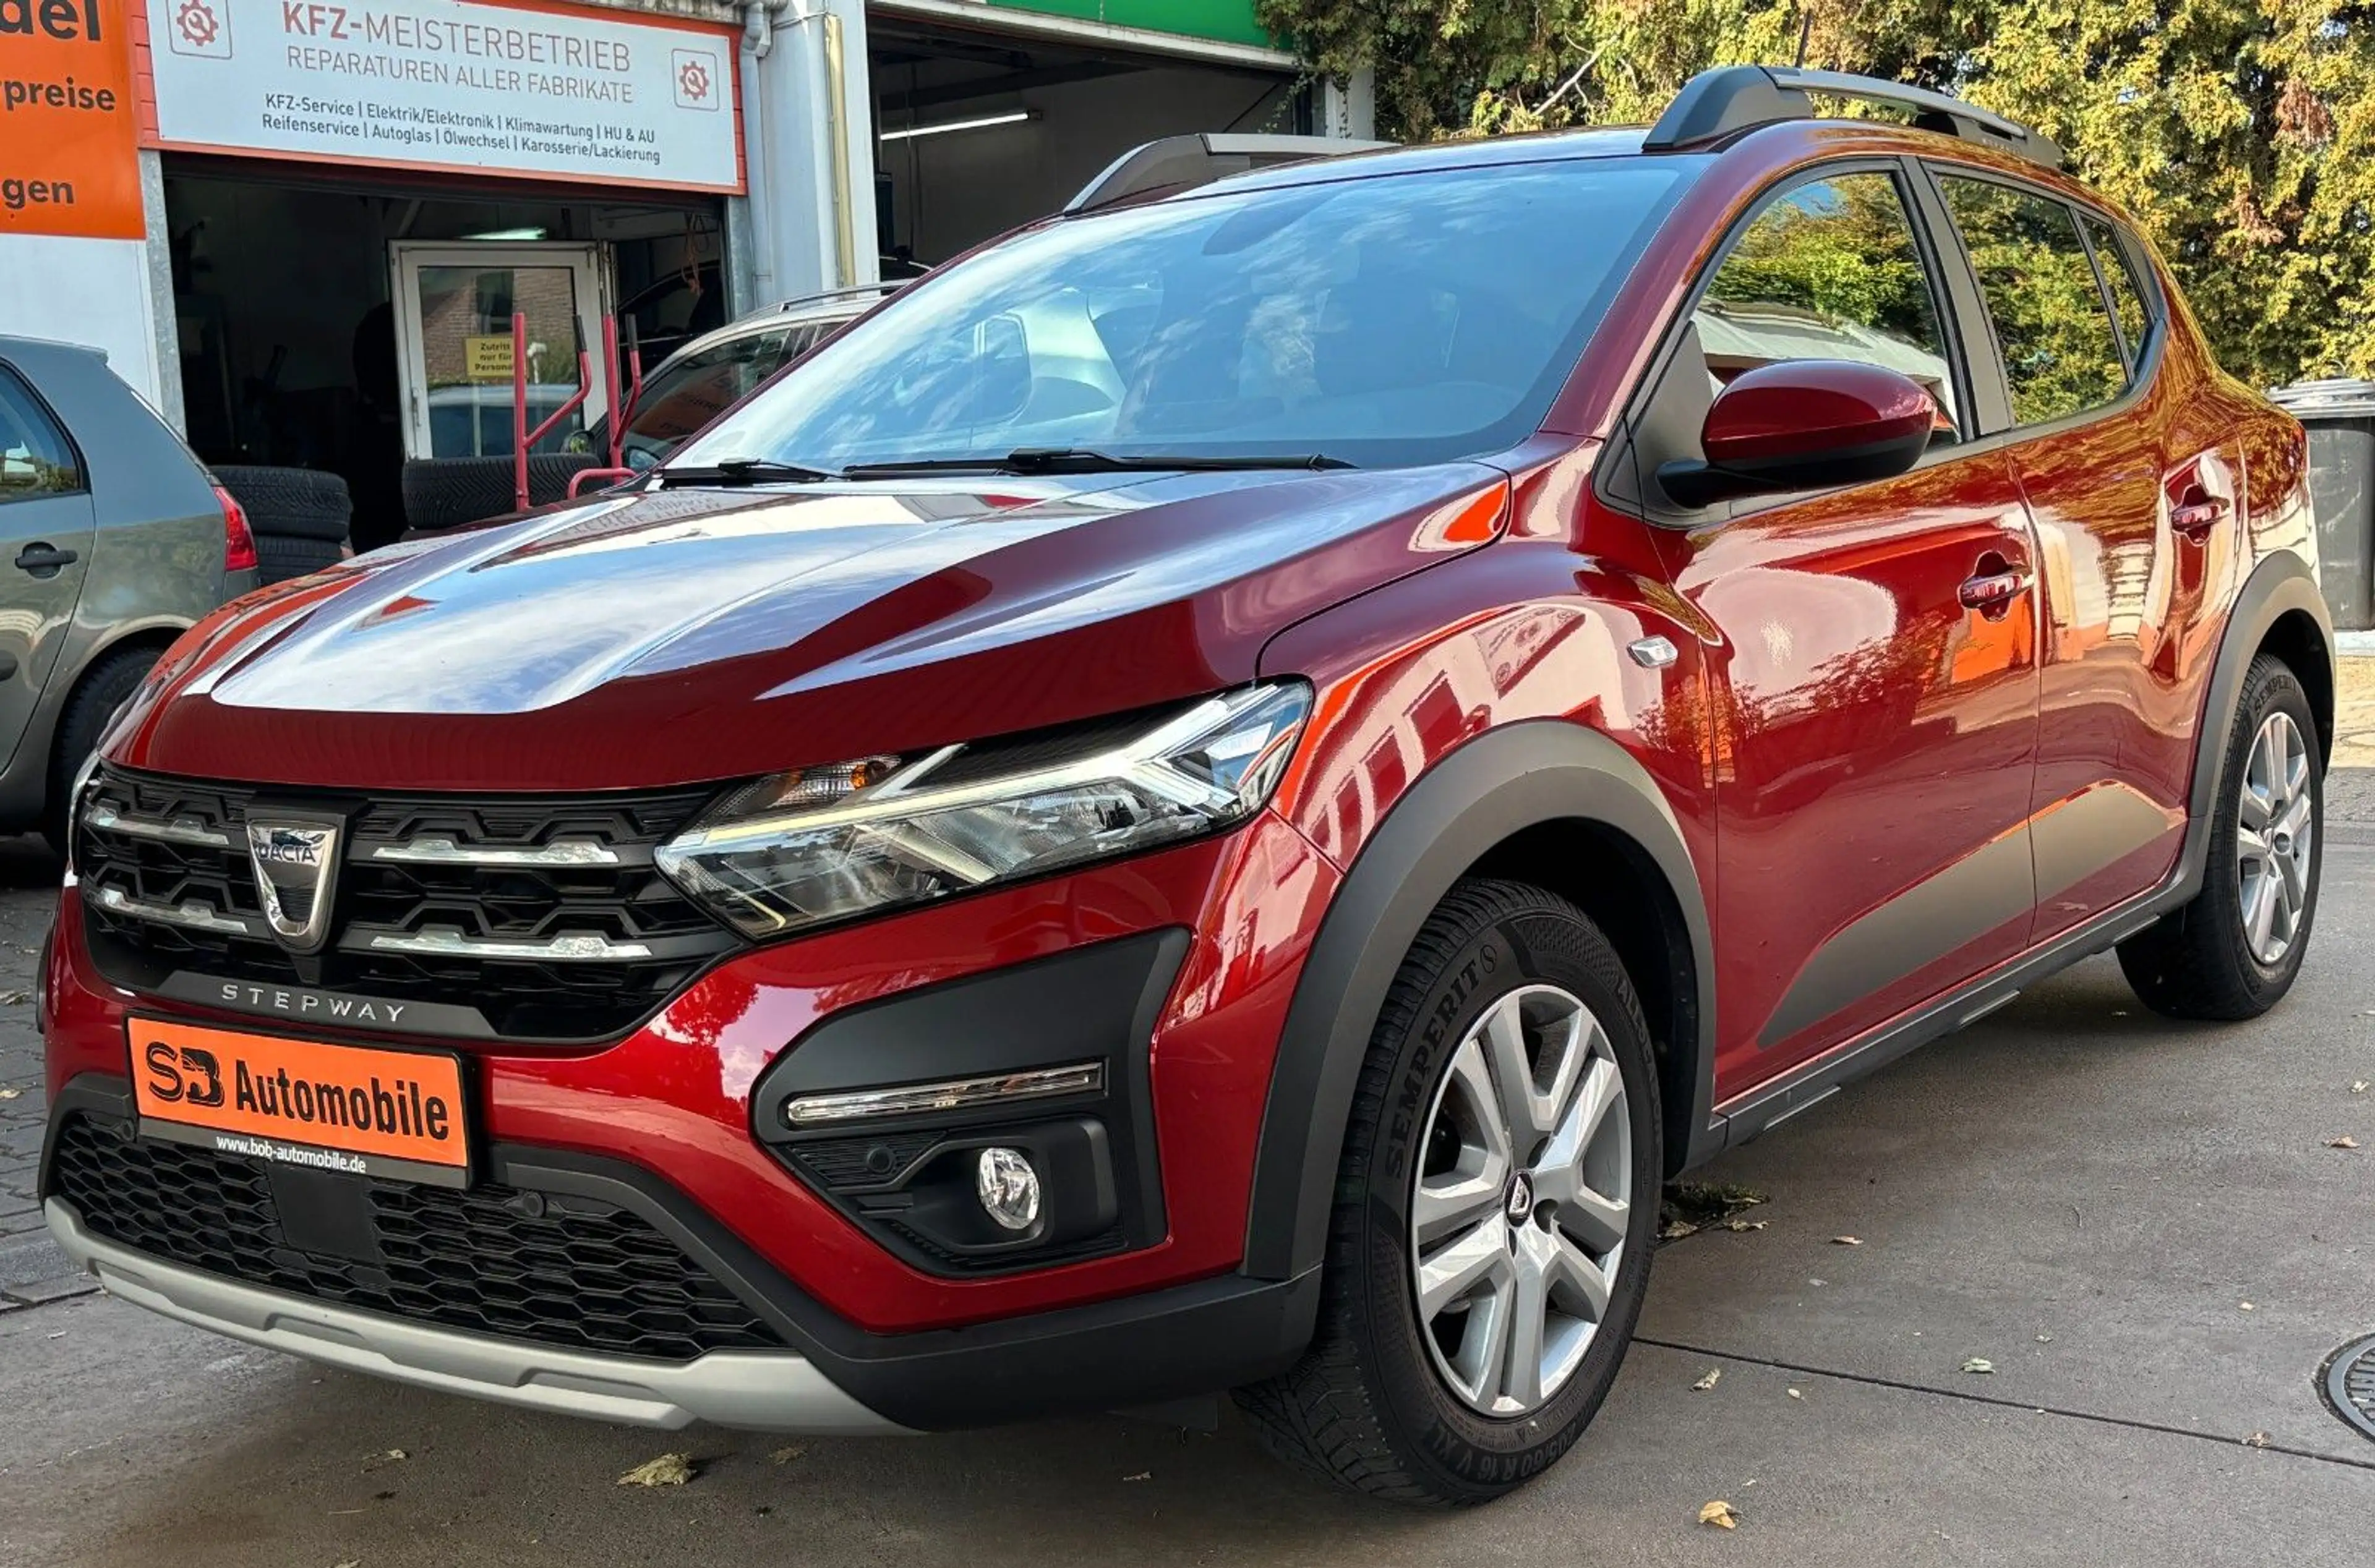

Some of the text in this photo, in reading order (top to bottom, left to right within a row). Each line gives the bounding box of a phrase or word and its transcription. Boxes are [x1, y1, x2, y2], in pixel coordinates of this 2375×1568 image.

[283, 1, 630, 72] KFZ-MEISTERBETRIEB
[0, 77, 116, 111] preise
[288, 46, 633, 103] REPARATUREN ALLER FABRIKATE
[262, 114, 359, 137] Reifenservice
[372, 124, 432, 145] Autoglas
[443, 128, 510, 150] Ölwechsel
[522, 137, 661, 166] Karosserie/Lackierung
[266, 93, 354, 116] KFZ-Service
[367, 103, 494, 129] Elektrik/Elektronik
[506, 116, 593, 142] Klimawartung
[605, 126, 622, 141] HU
[626, 128, 635, 142] &
[638, 129, 654, 143] AU
[2, 178, 74, 210] gen
[258, 843, 317, 863] DACIA
[221, 984, 404, 1022] STEPWAY
[1385, 958, 1479, 1178] SEMPERIT
[236, 1059, 449, 1141] Automobile
[216, 1135, 367, 1174] www.bob-automobile.de
